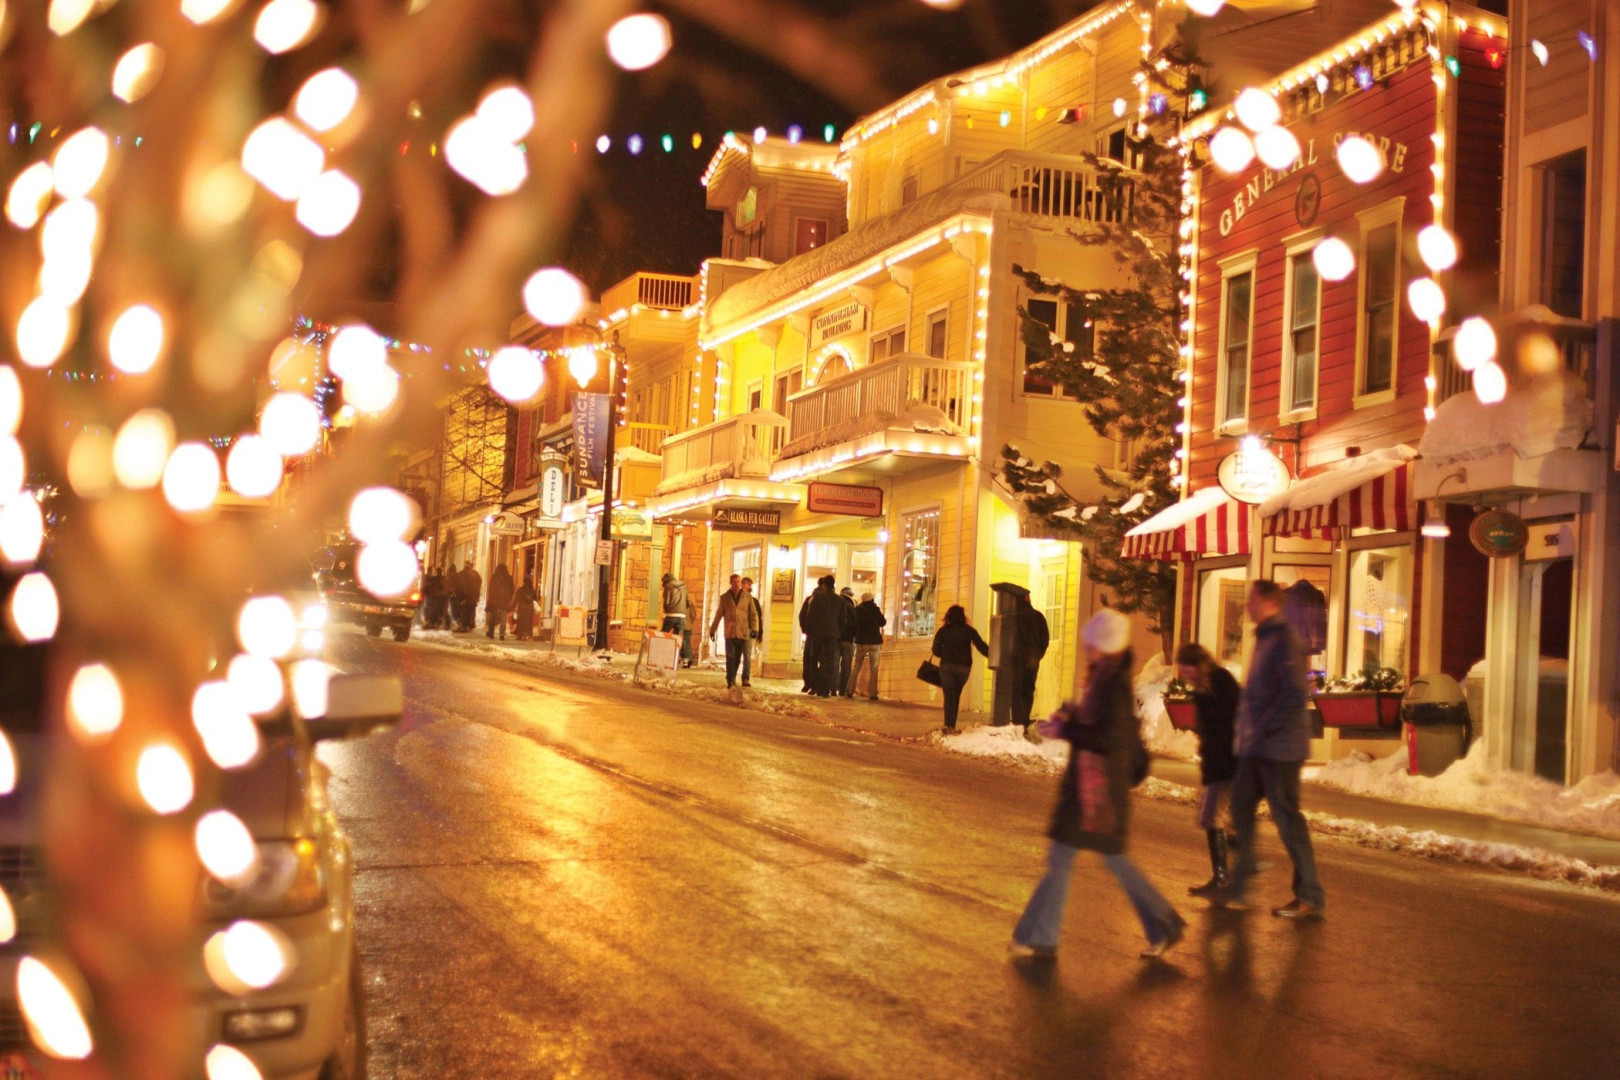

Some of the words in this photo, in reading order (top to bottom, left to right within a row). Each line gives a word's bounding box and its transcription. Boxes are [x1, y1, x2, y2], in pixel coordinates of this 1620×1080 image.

[1332, 131, 1408, 173] SRE
[822, 320, 852, 341] BUILDING
[577, 391, 588, 477] SUNDANCE
[587, 438, 595, 459] FILM
[730, 511, 748, 523] ALASKA
[758, 513, 780, 526] GALLERY
